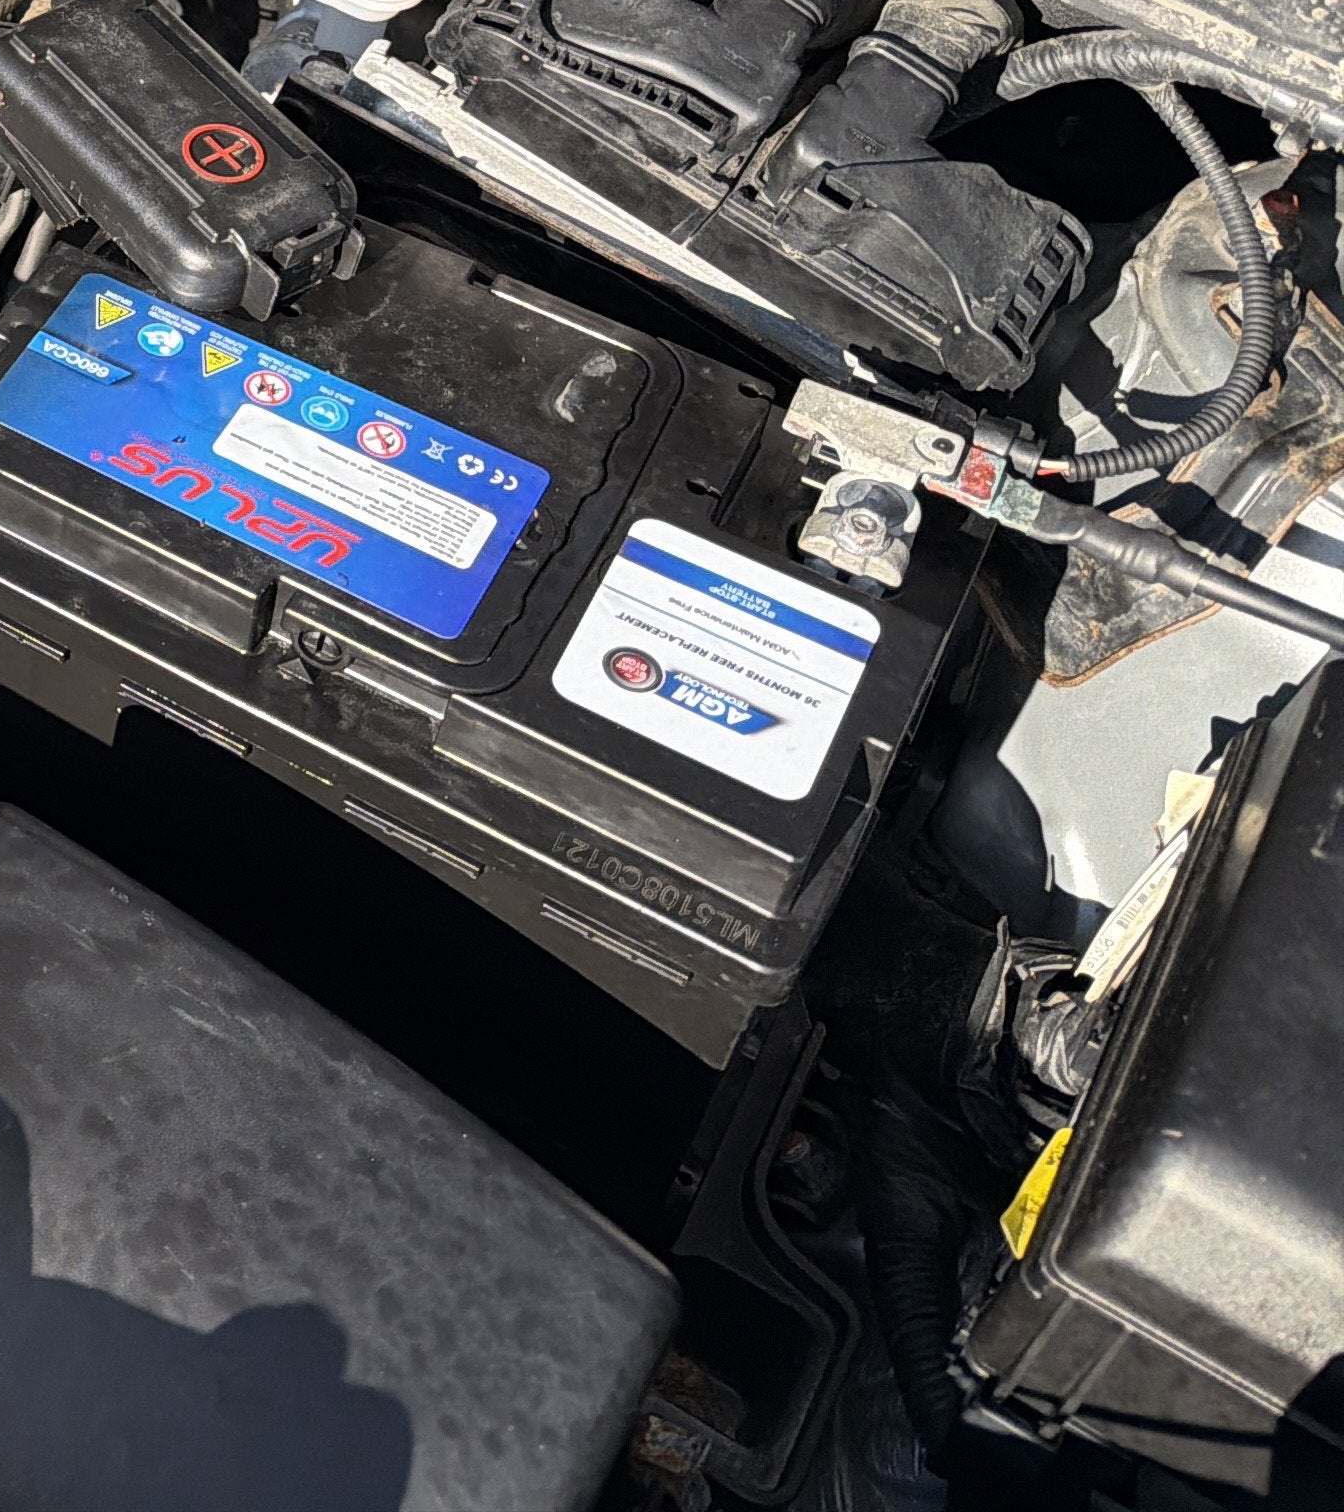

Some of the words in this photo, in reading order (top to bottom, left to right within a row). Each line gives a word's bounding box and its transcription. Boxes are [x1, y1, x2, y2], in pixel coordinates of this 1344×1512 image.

[42, 339, 111, 380] 660CCA
[109, 440, 352, 569] UPLUS
[666, 595, 692, 613] Free
[719, 580, 771, 610] BATTERY
[615, 612, 709, 657] REPLACEMENT
[691, 605, 762, 644] Maintenance
[708, 651, 744, 675] FREE
[760, 636, 791, 657] AGM
[672, 669, 751, 713] TECHNOLOGY
[743, 667, 802, 701] MONTHS
[802, 694, 821, 710] 36
[672, 683, 753, 728] AGM
[552, 831, 759, 949] ML5108C0121
